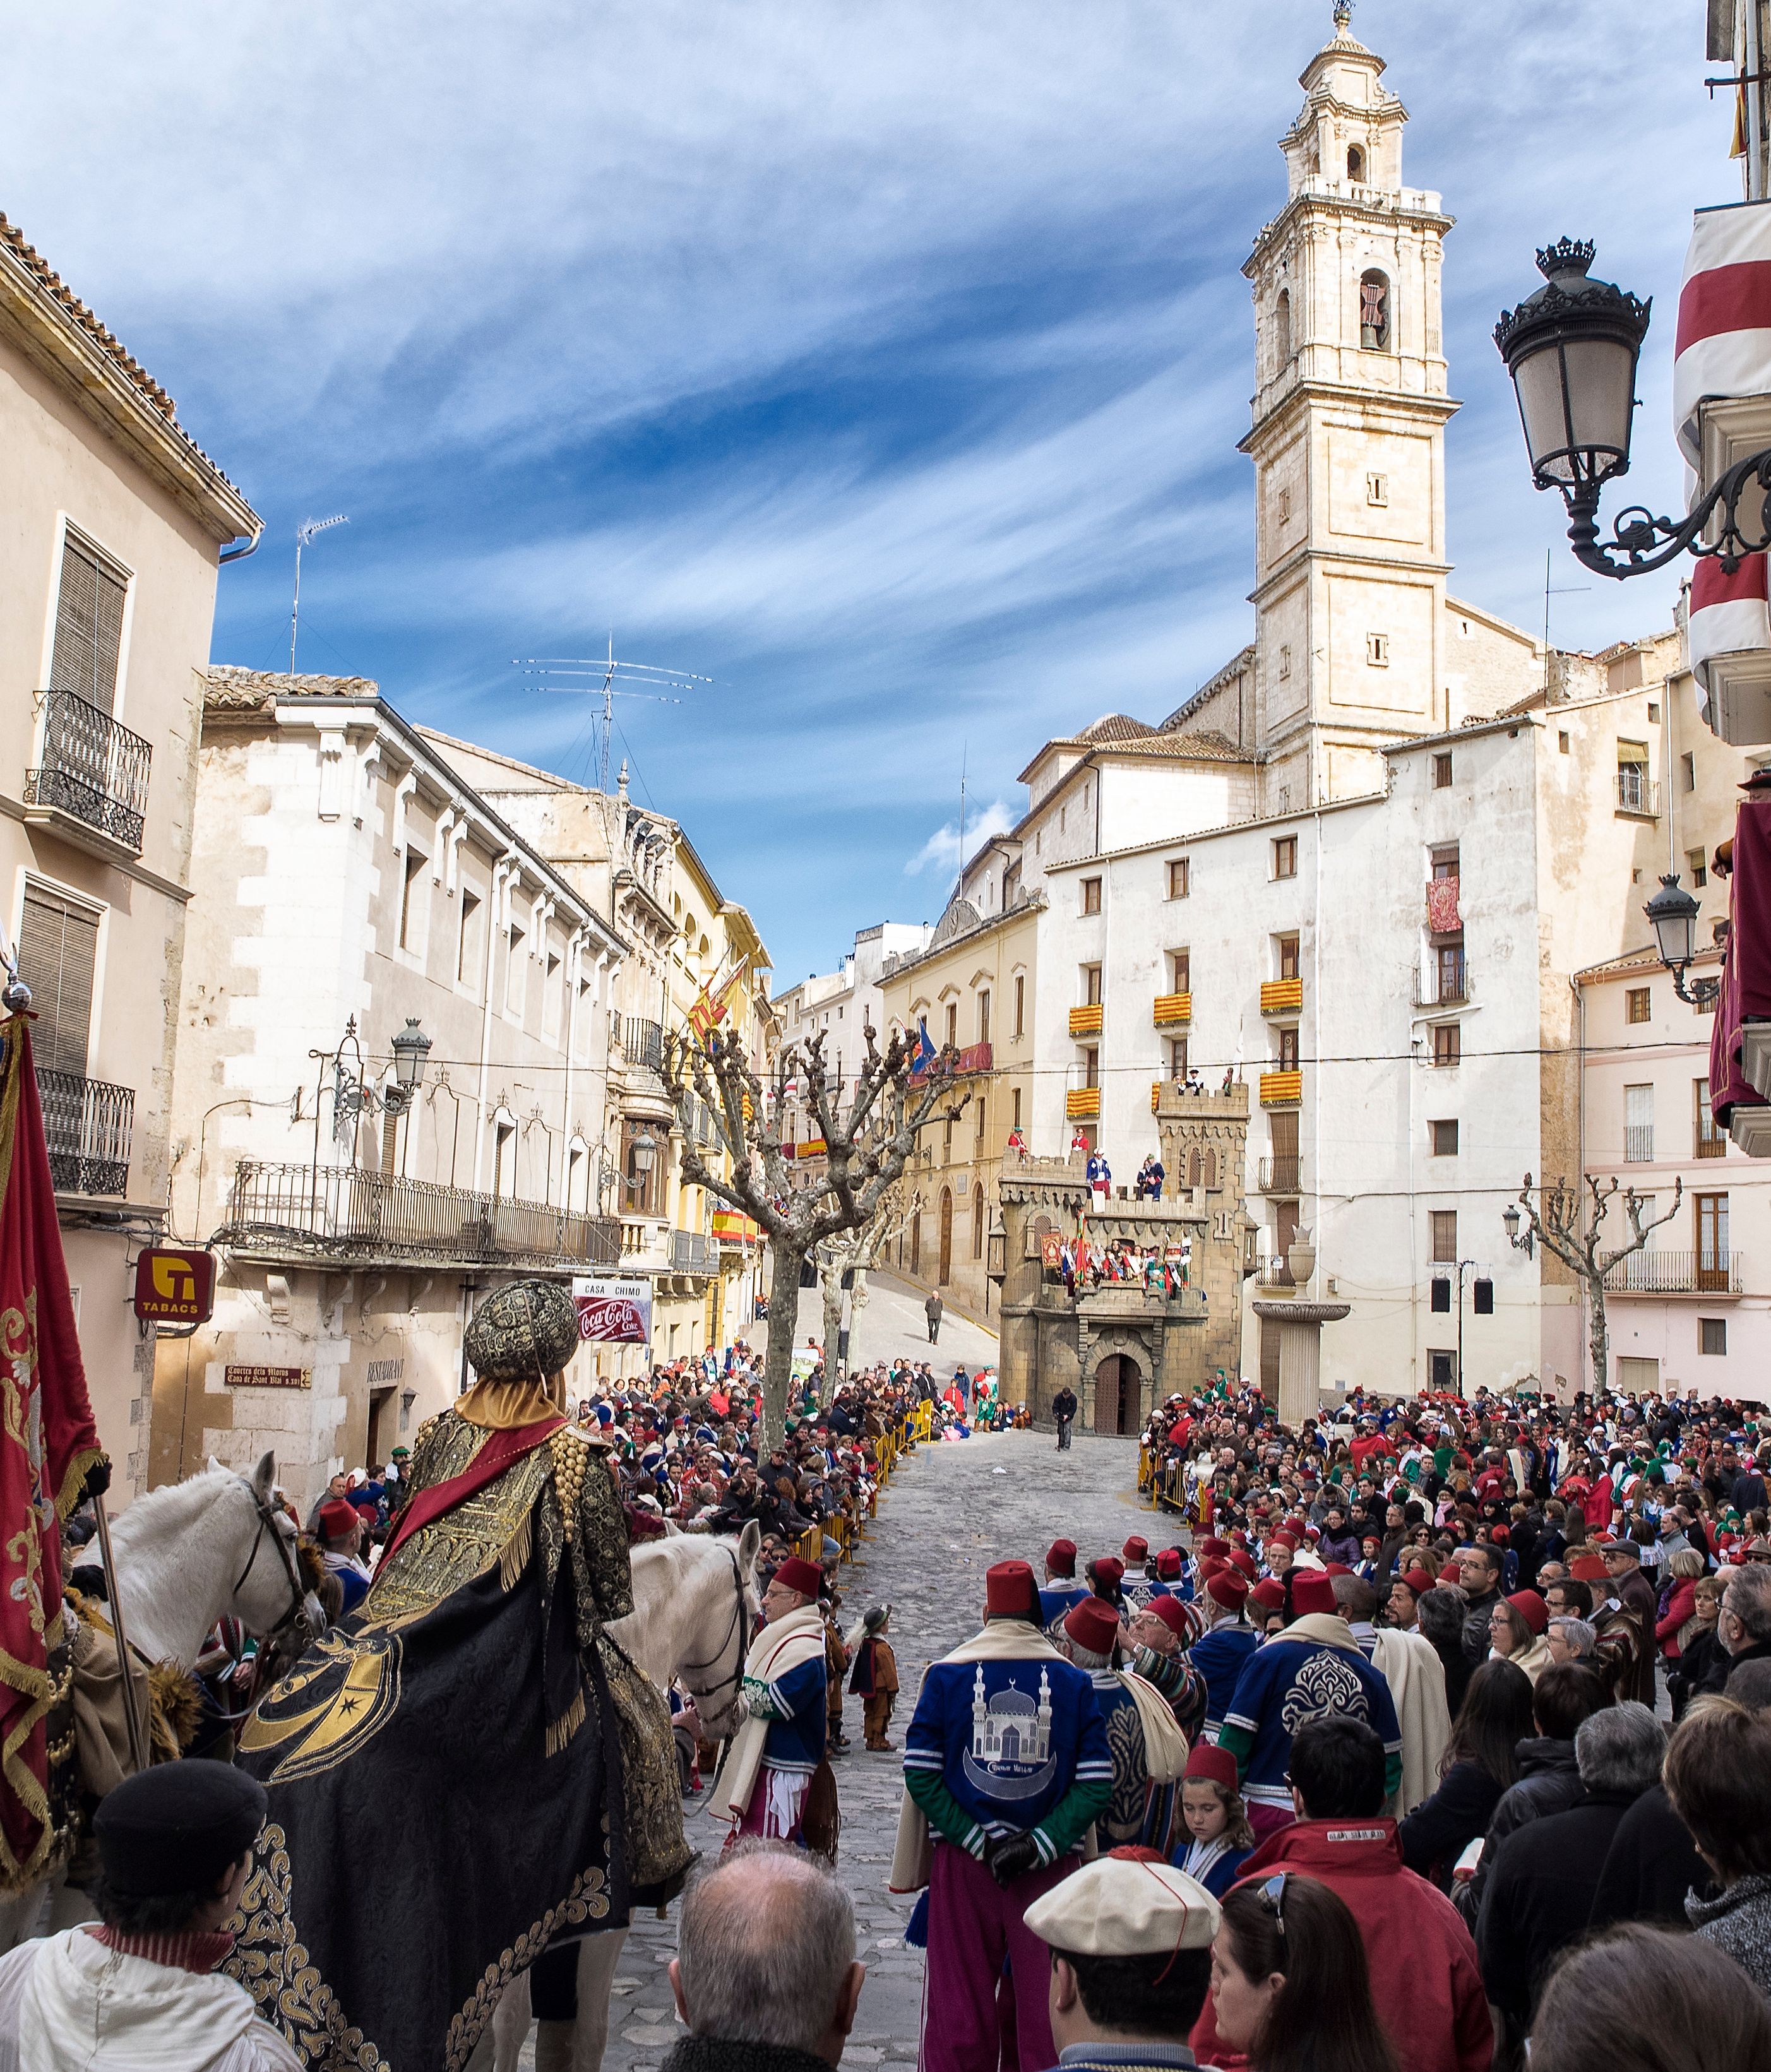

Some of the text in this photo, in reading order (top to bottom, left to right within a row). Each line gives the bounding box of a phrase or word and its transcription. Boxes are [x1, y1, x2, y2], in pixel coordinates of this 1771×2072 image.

[585, 1285, 641, 1296] CASA CHIMO
[143, 1302, 198, 1314] TABACS
[581, 1301, 633, 1338] Coca-Cola
[253, 1367, 266, 1376] dels
[366, 1358, 405, 1383] RESTAURANT
[244, 1375, 250, 1383] de
[251, 1376, 268, 1384] Sant
